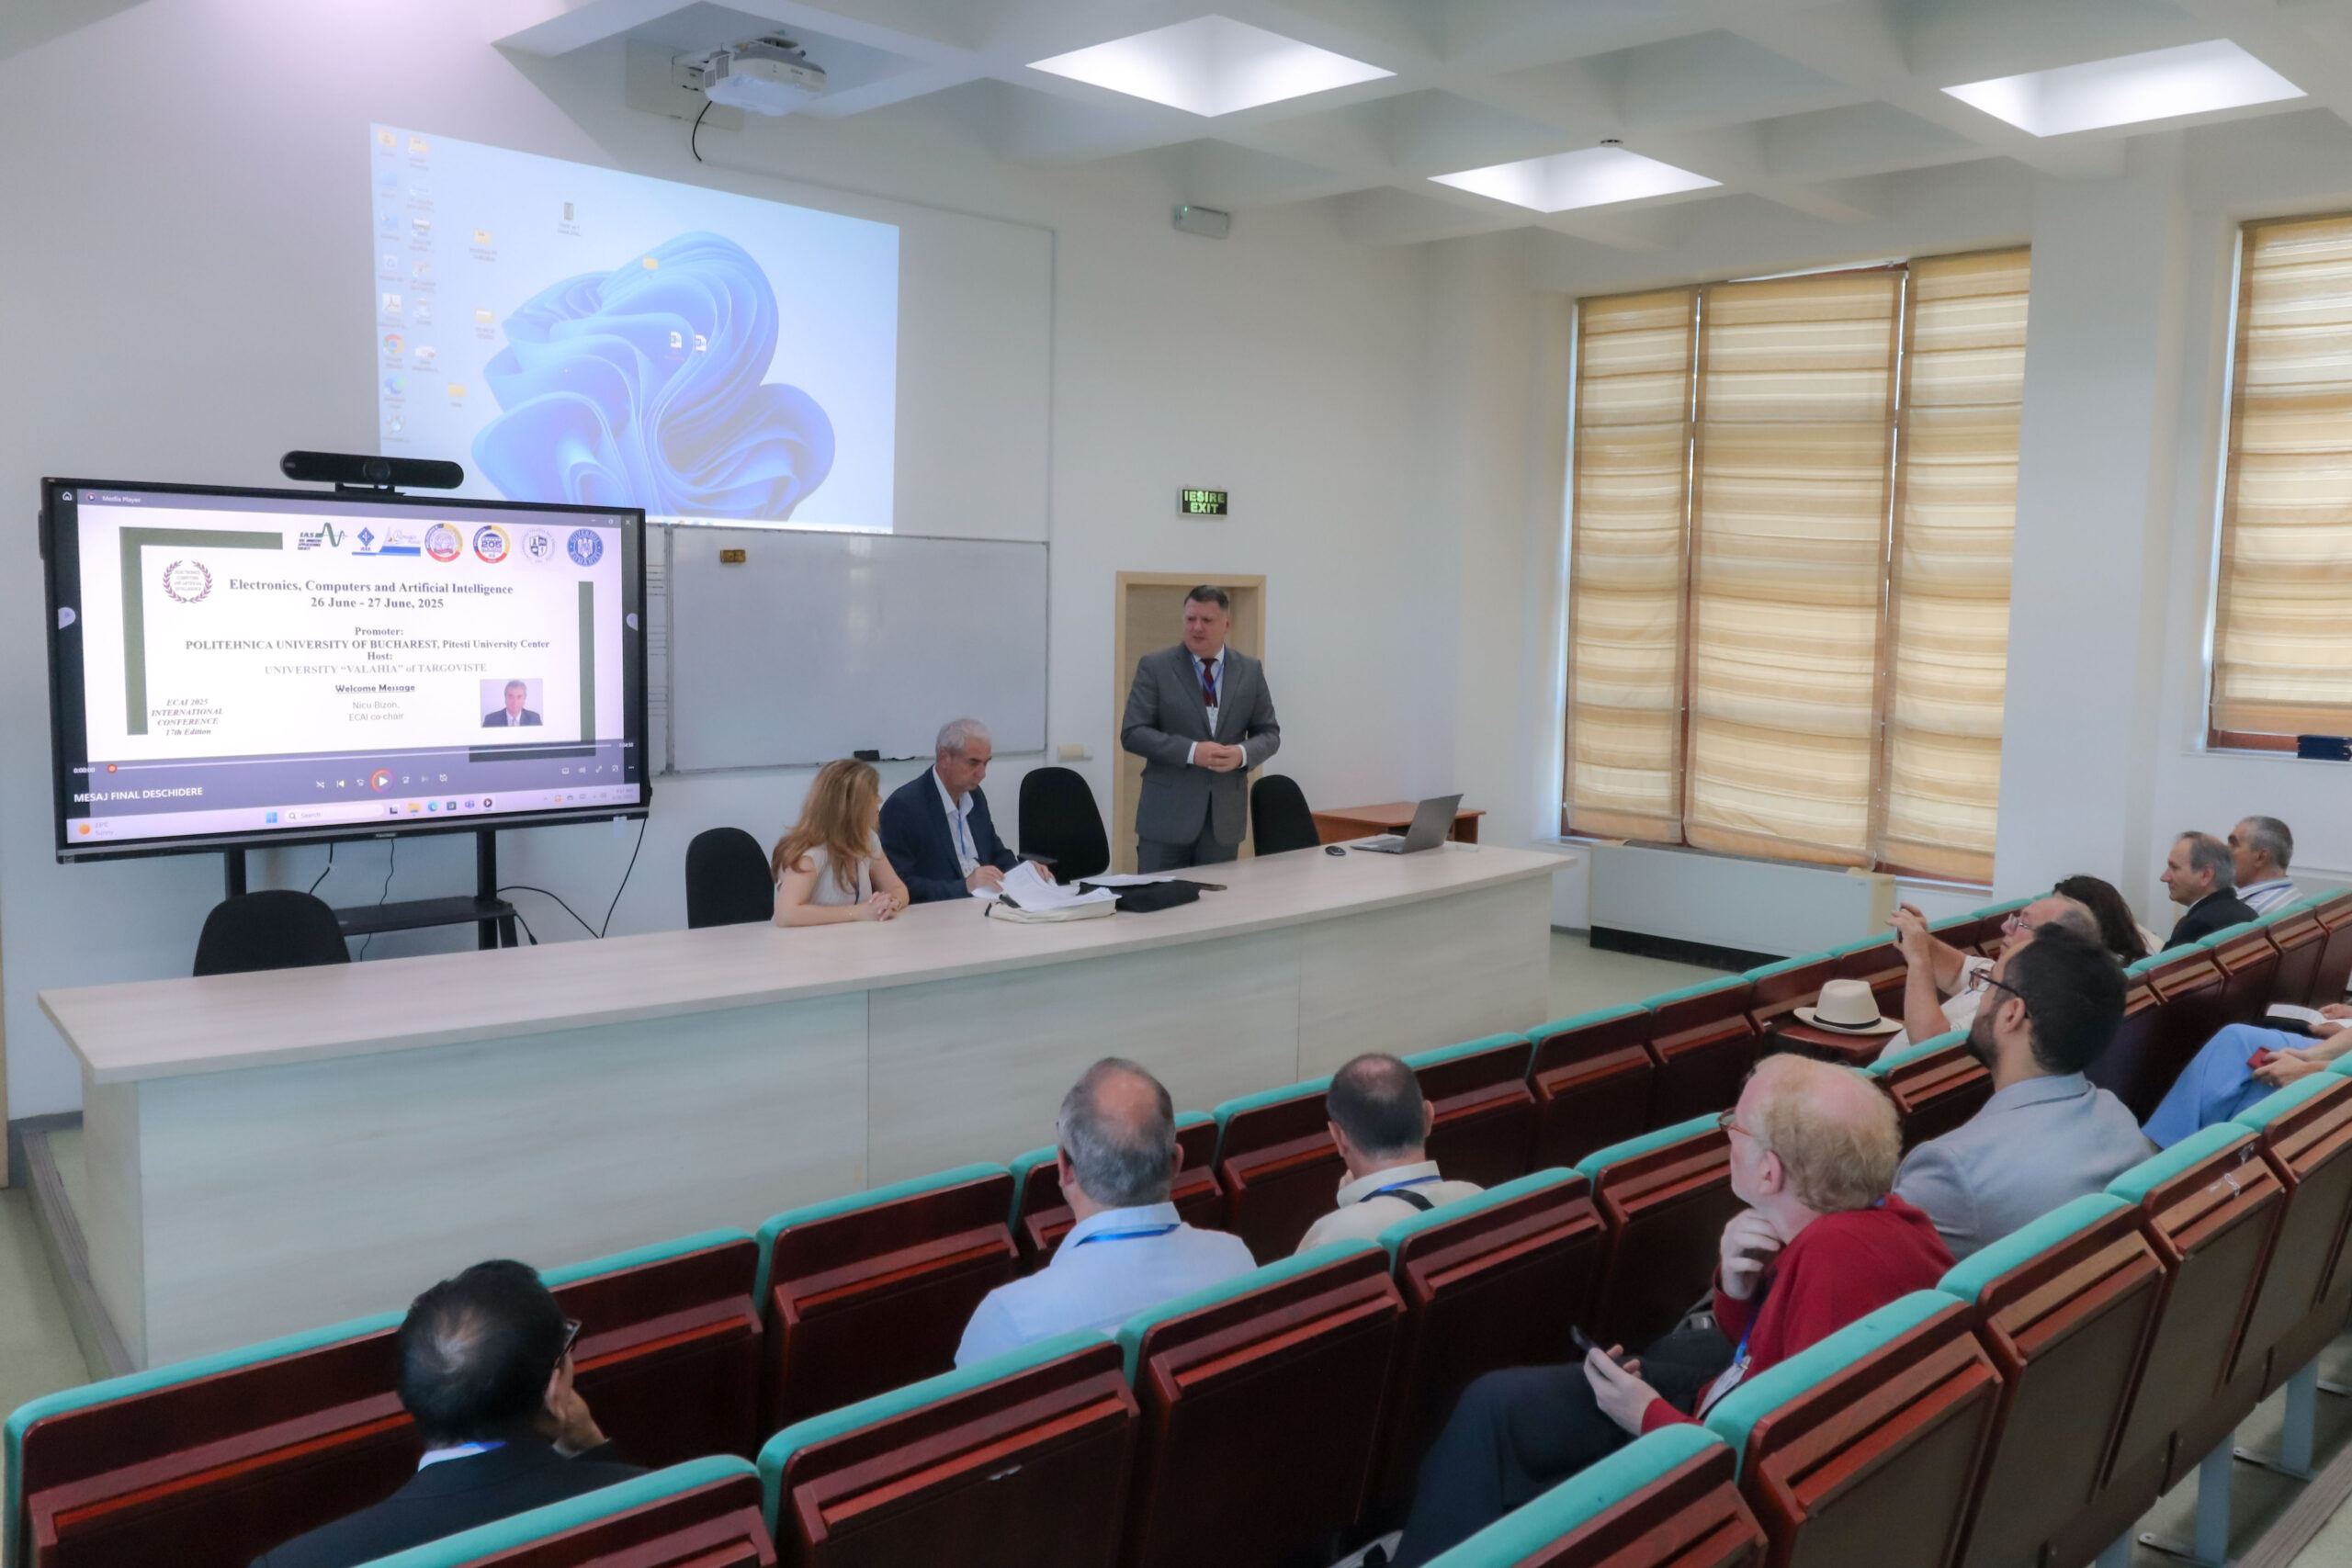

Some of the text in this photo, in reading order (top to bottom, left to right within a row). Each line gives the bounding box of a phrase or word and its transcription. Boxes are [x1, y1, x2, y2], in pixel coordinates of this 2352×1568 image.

[1190, 502, 1219, 513] EXIT
[481, 540, 502, 548] 205
[229, 579, 514, 595] Electronics, Computers and Artificial Intelligence
[311, 597, 324, 607] 26
[328, 597, 356, 608] June
[368, 598, 381, 607] 27
[384, 598, 414, 609] June,
[418, 598, 444, 608] 2025
[355, 626, 404, 636] Promoter:
[186, 639, 550, 650] POLITEHNICA UNIVERSITY OF BUCHAREST, Pitesti University Center
[368, 651, 393, 660] Host:
[265, 665, 339, 674] UNIVERSITY
[406, 664, 415, 673] of
[417, 663, 487, 673] TARGOVISTE
[335, 683, 415, 694] Welcome Message
[166, 698, 188, 706] ECAI
[352, 701, 372, 709] Nicu
[152, 707, 224, 716] INTERNATIONAL
[348, 712, 404, 721] ECAI co-chair
[157, 717, 220, 726] CONFERENCE
[184, 728, 211, 736] Edition
[74, 787, 203, 803] MESAJ FINAL DESCHIDERE
